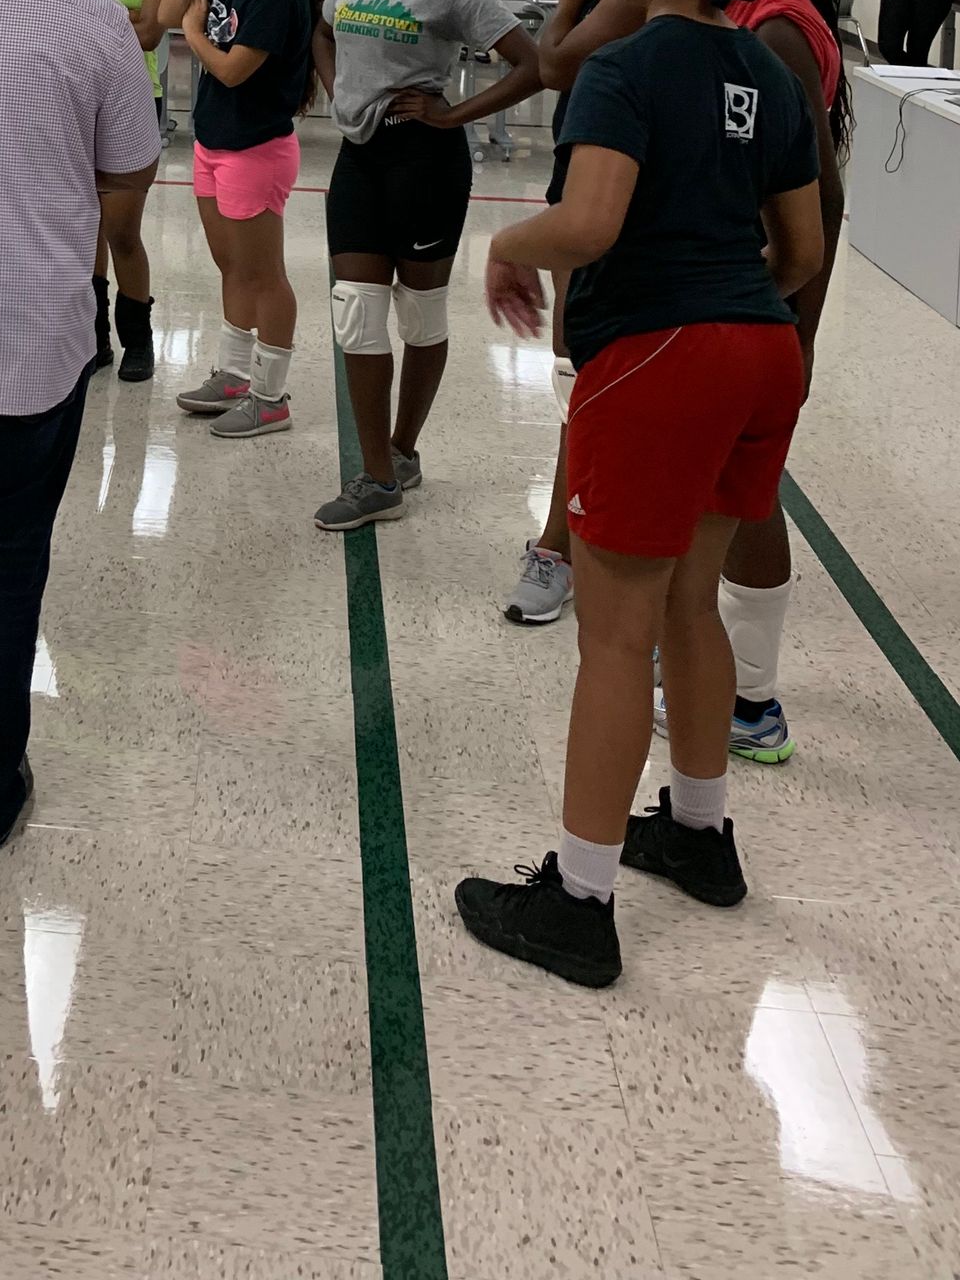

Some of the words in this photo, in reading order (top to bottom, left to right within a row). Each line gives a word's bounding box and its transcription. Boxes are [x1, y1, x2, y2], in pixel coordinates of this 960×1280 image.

[335, 20, 380, 38] RUNNING
[383, 28, 419, 45] CLUB
[339, 7, 419, 33] SHARPSTOWN
